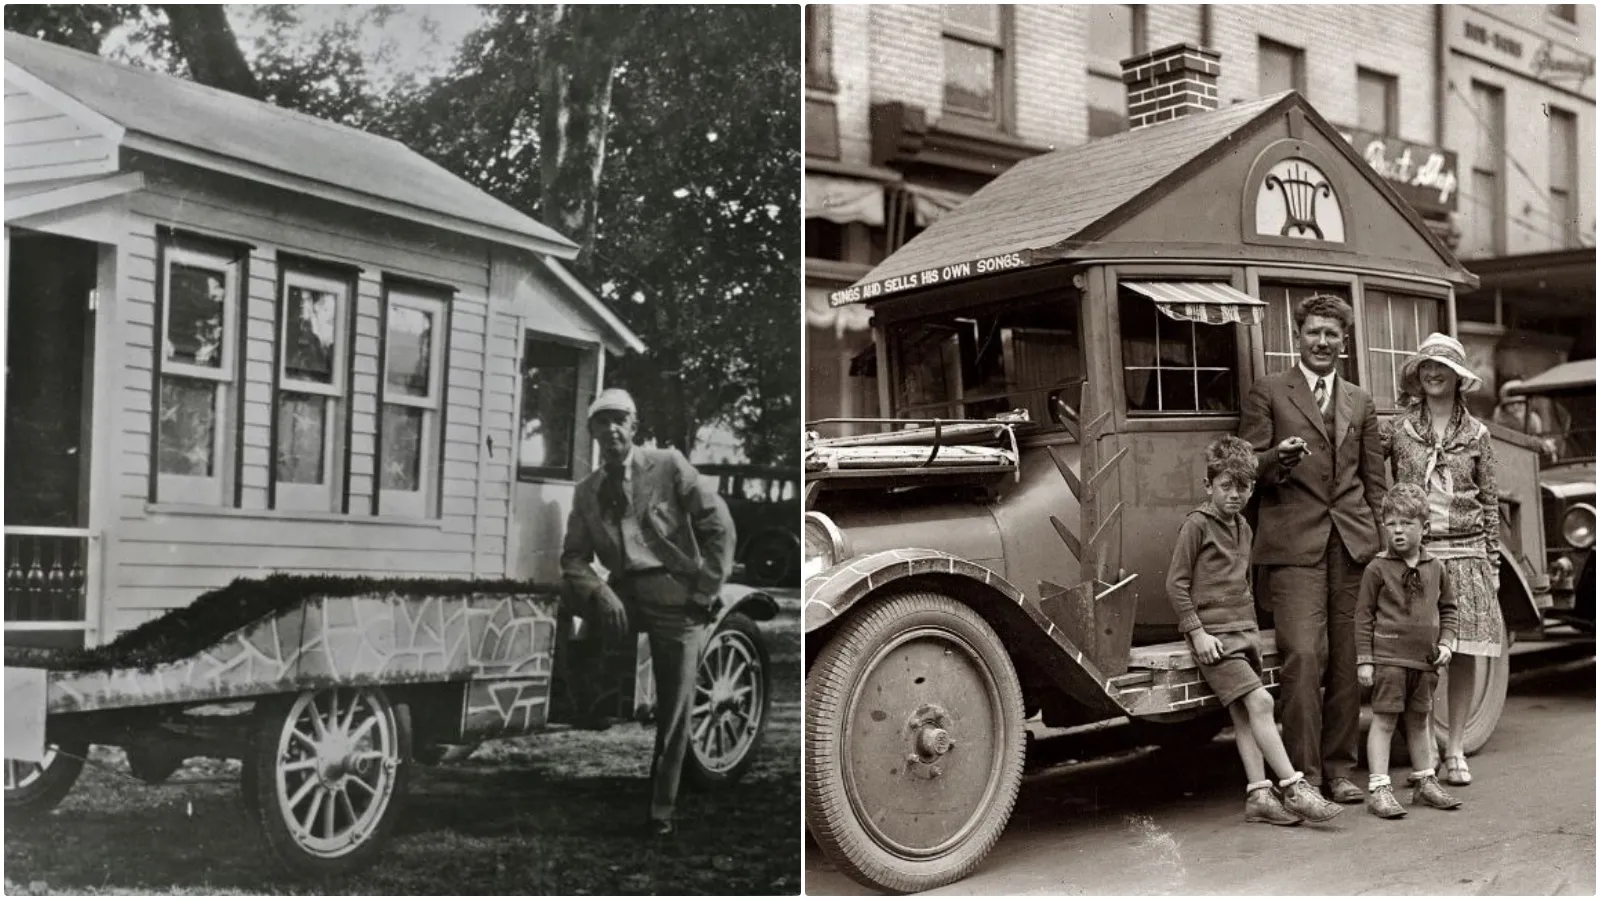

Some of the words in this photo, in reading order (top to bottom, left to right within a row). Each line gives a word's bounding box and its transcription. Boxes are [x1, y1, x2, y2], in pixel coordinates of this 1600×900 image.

[831, 286, 860, 306] SINGS
[863, 282, 881, 299] AND
[884, 274, 917, 293] SELLS
[921, 269, 939, 285] HIS
[942, 262, 970, 280] OWN
[977, 253, 1024, 273] SONGS.
